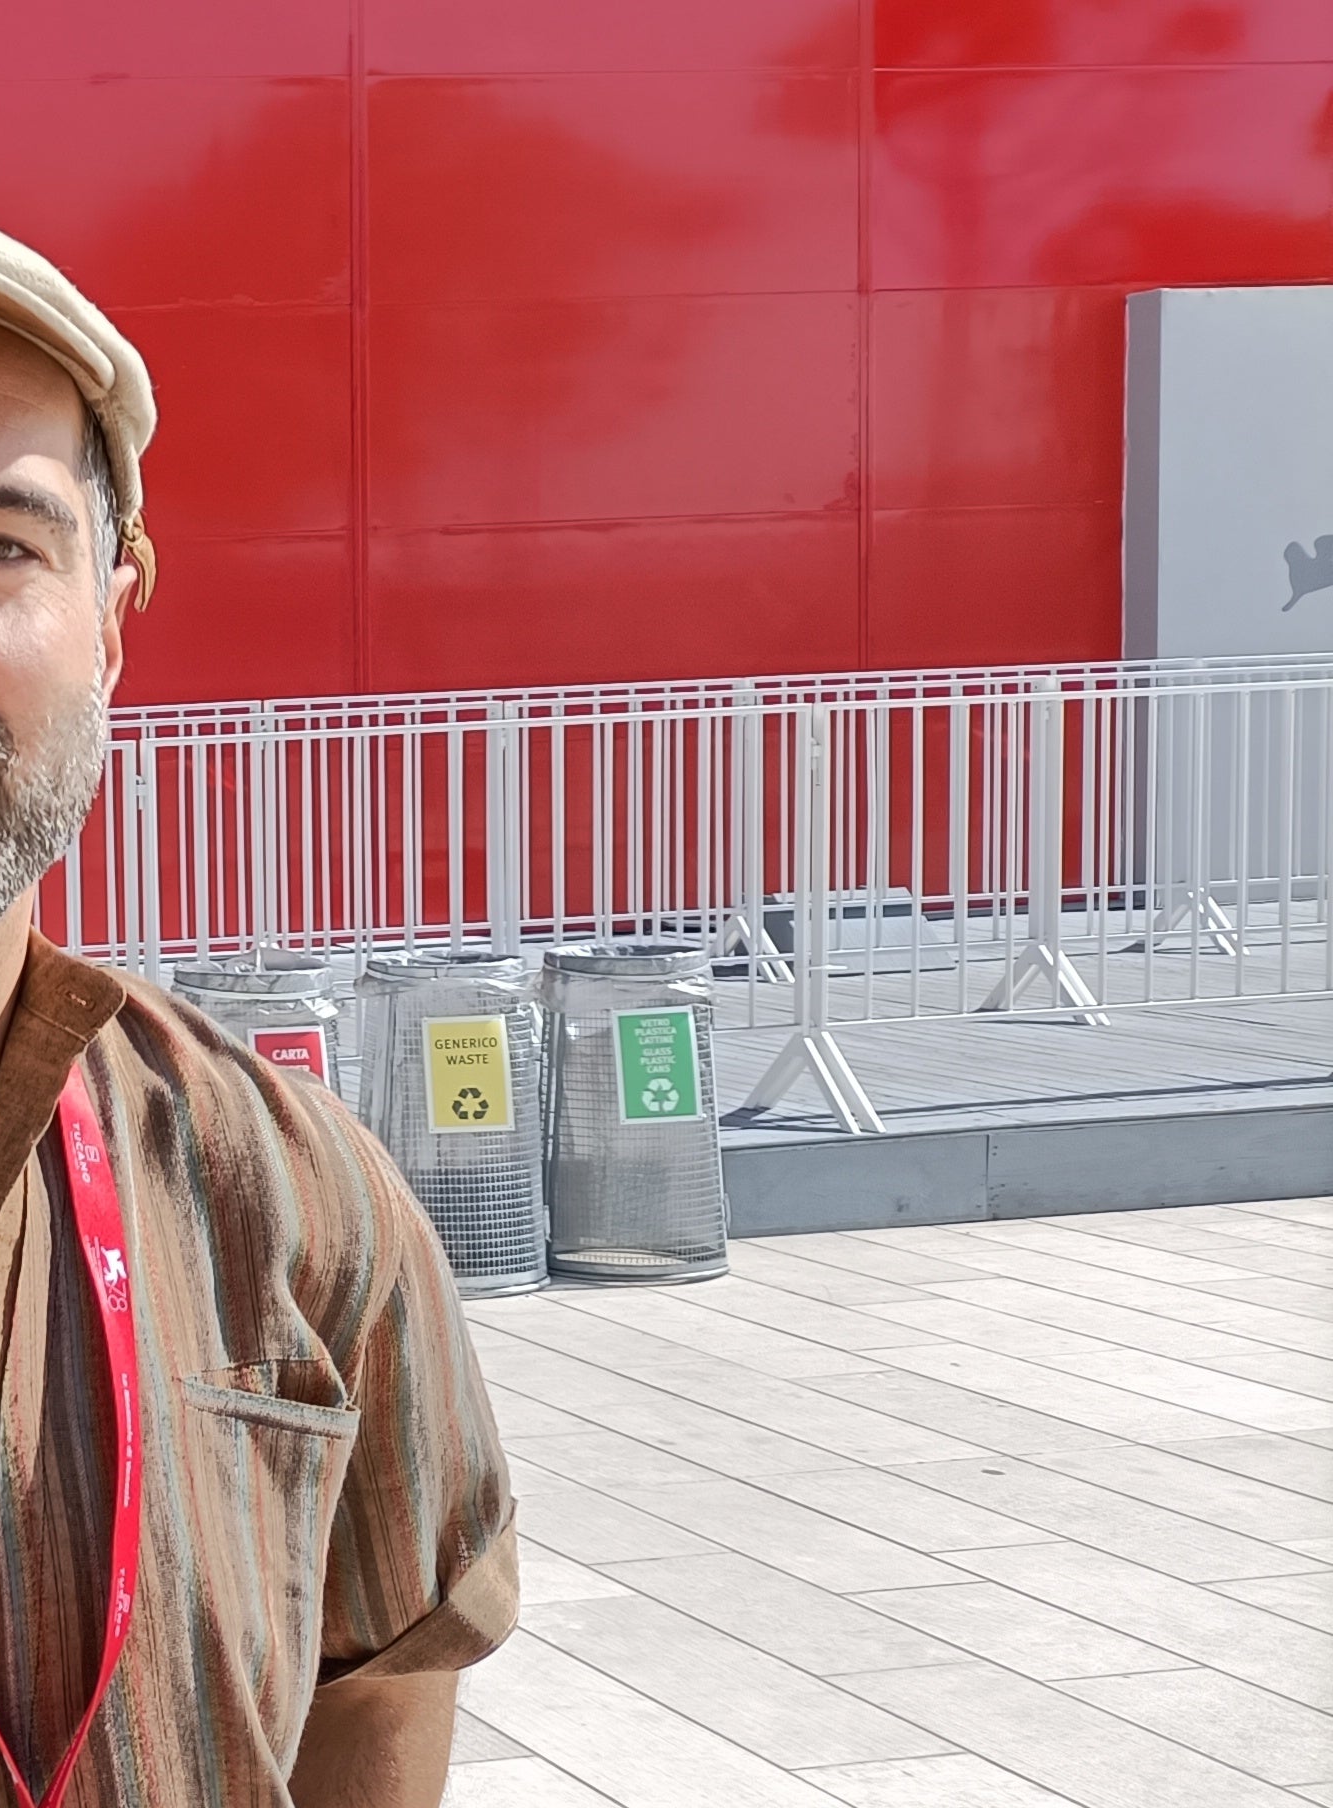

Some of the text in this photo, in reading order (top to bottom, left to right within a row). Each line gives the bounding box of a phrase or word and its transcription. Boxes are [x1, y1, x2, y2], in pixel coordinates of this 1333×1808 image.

[634, 1026, 677, 1037] PLASTICA
[434, 1037, 498, 1050] GENERICO
[272, 1048, 310, 1061] CARTA
[643, 1046, 673, 1056] GLASS
[446, 1054, 489, 1065] WASTE
[72, 1122, 91, 1183] TUCANO
